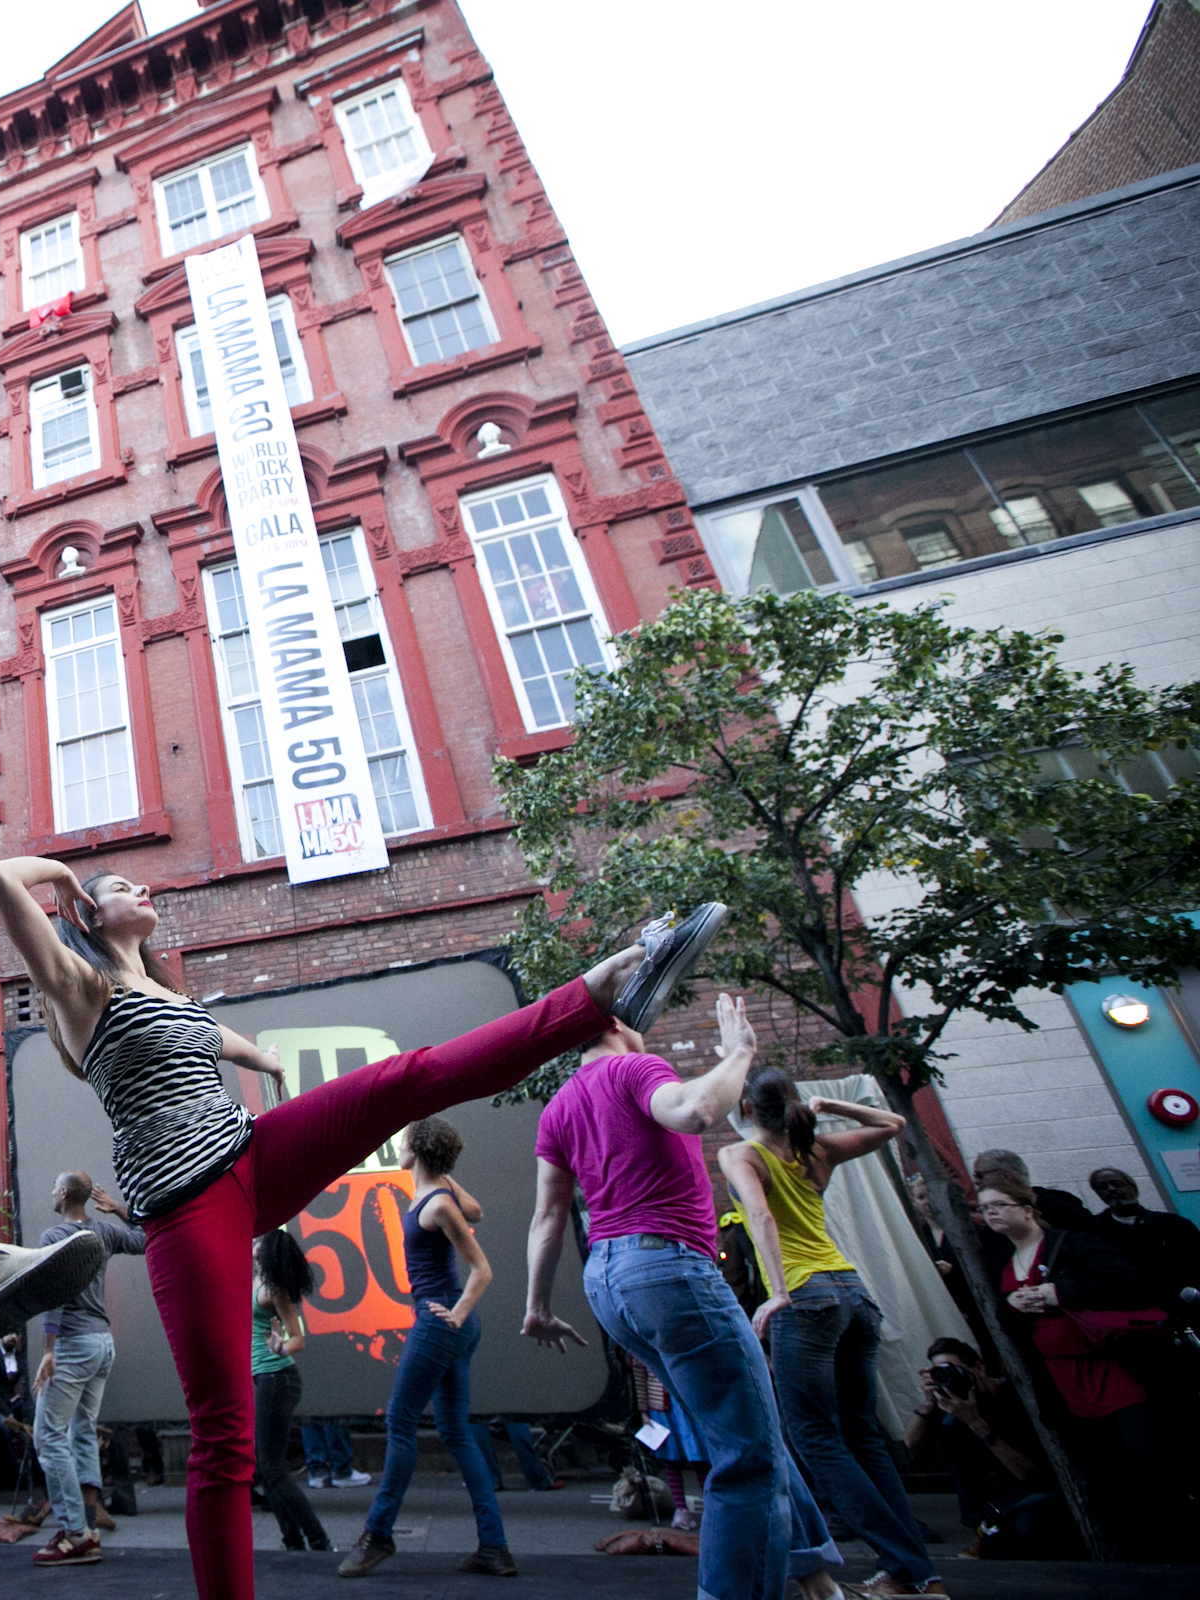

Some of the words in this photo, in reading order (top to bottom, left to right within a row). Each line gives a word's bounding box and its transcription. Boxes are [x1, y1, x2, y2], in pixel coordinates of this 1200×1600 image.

[206, 283, 248, 320] LA
[212, 316, 265, 404] MAMA
[229, 400, 273, 442] 50
[231, 441, 288, 470] WORLD
[235, 457, 292, 489] BLOCK
[238, 476, 294, 509] PARTY
[245, 512, 304, 548] GALA
[257, 561, 309, 611] LA
[265, 611, 335, 732] MAMA
[287, 736, 347, 790] 50
